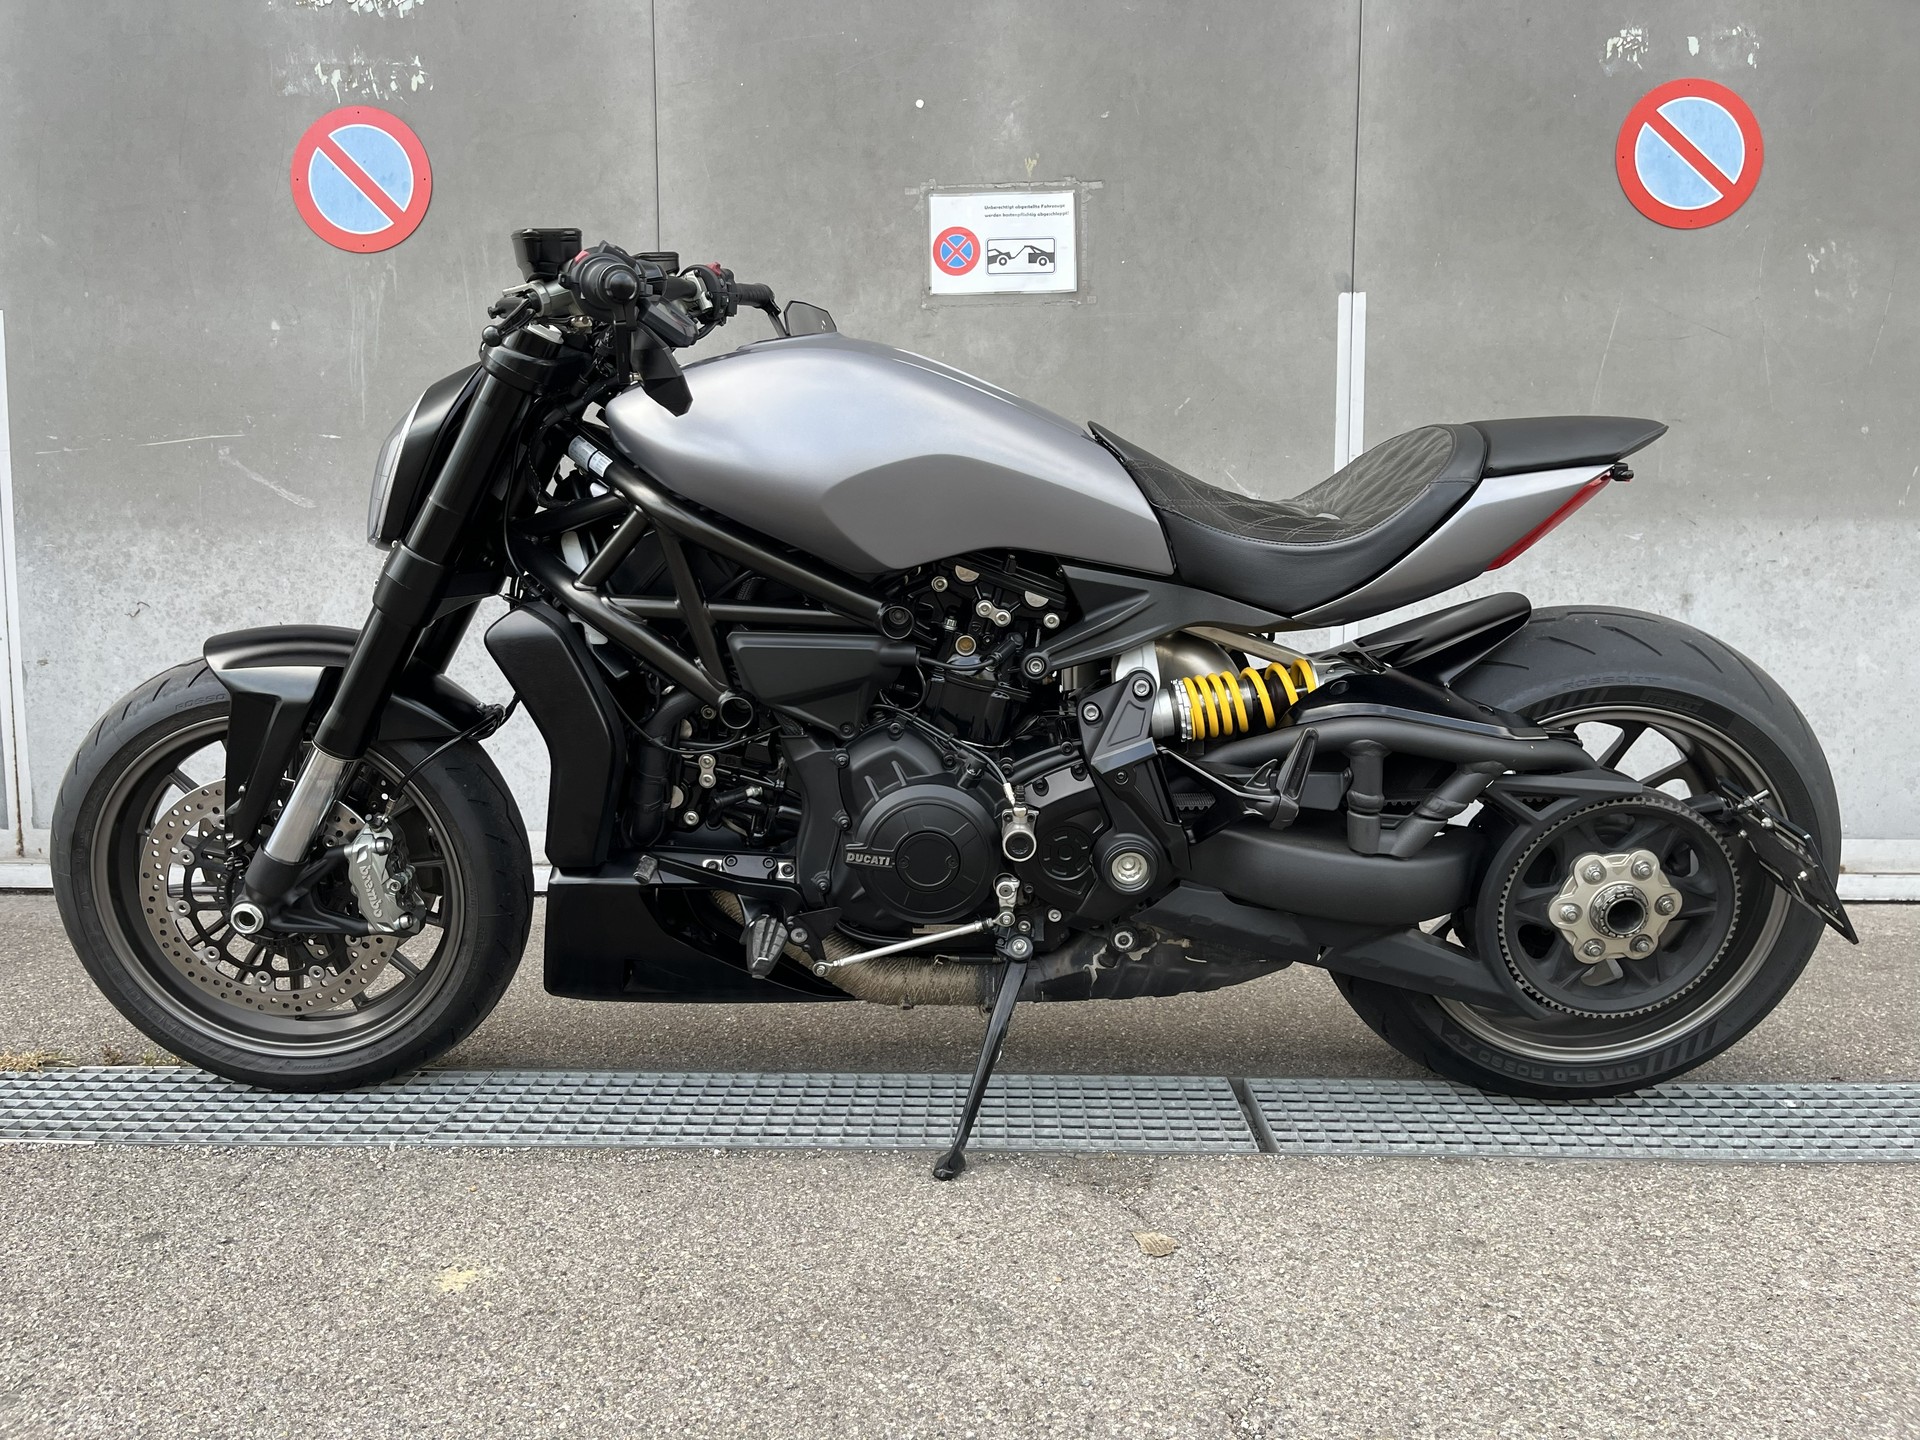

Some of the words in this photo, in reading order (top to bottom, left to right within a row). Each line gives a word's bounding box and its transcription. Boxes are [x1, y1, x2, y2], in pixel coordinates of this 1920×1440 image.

[175, 693, 226, 711] ROSSO
[846, 852, 890, 866] DUCATI
[359, 864, 383, 918] brembo
[1478, 1050, 1545, 1079] ROSSO
[1553, 1063, 1640, 1082] DIABLO
